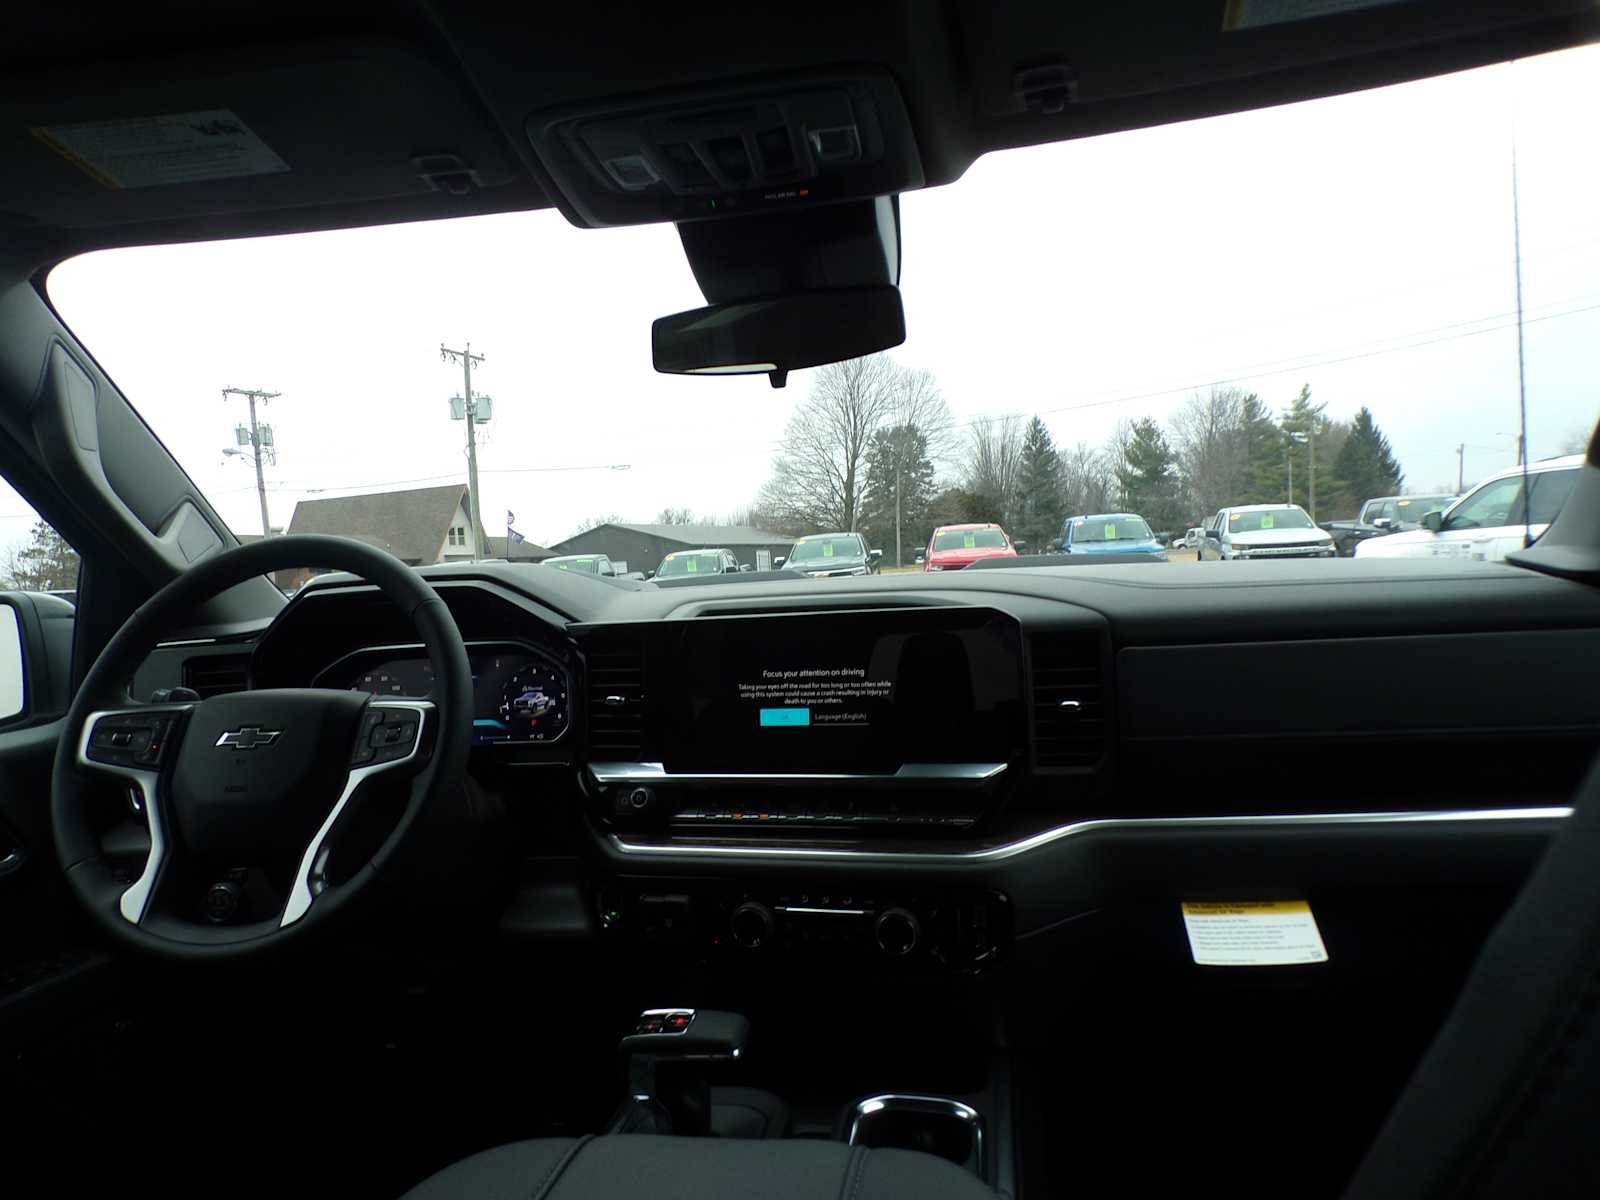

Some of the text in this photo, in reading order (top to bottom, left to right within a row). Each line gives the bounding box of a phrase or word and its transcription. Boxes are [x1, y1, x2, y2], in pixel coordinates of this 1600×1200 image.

[762, 670, 783, 678] Focus
[784, 671, 798, 679] your
[799, 669, 829, 677] attention
[841, 667, 864, 678] driving
[738, 684, 755, 692] Taking
[836, 689, 860, 697] resulting
[866, 689, 882, 697] injury
[814, 712, 868, 721] Language (English)
